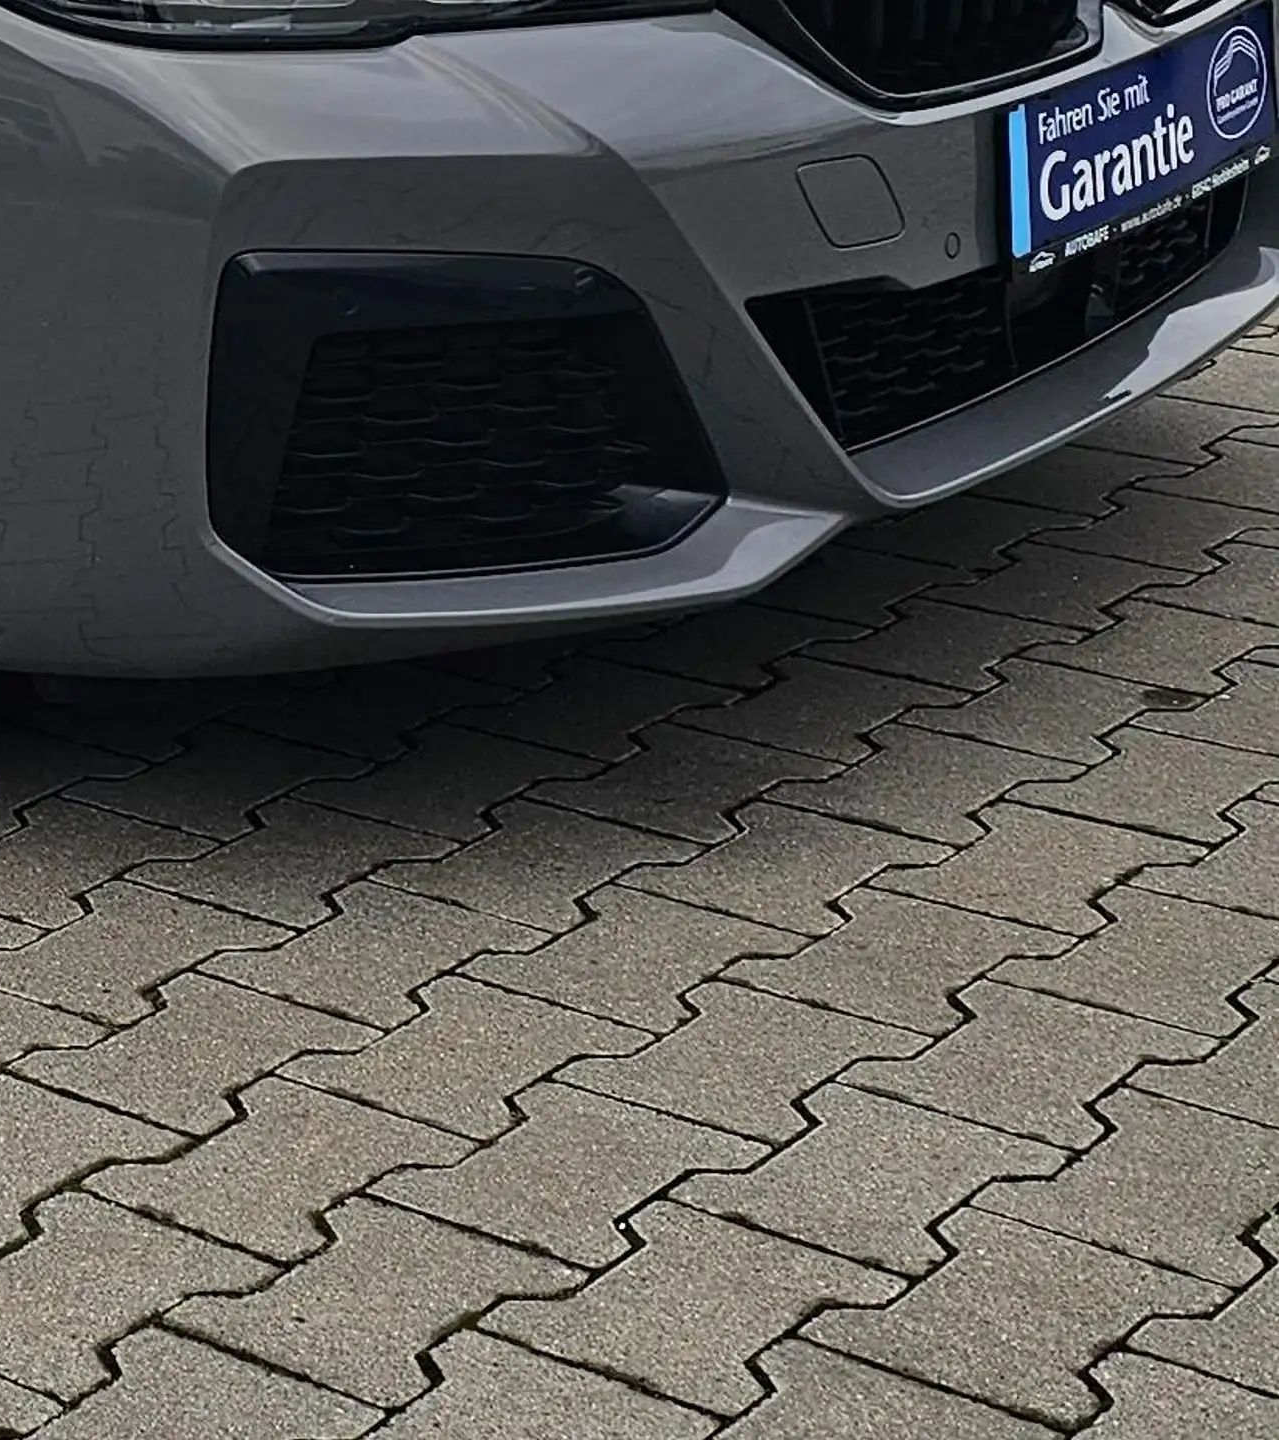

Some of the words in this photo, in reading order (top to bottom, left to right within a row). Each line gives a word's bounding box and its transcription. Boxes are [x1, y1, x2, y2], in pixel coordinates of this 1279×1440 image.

[1038, 103, 1093, 145] Fahren
[1097, 87, 1120, 122] Sie
[1124, 74, 1151, 112] mit
[1040, 103, 1195, 222] Garantie
